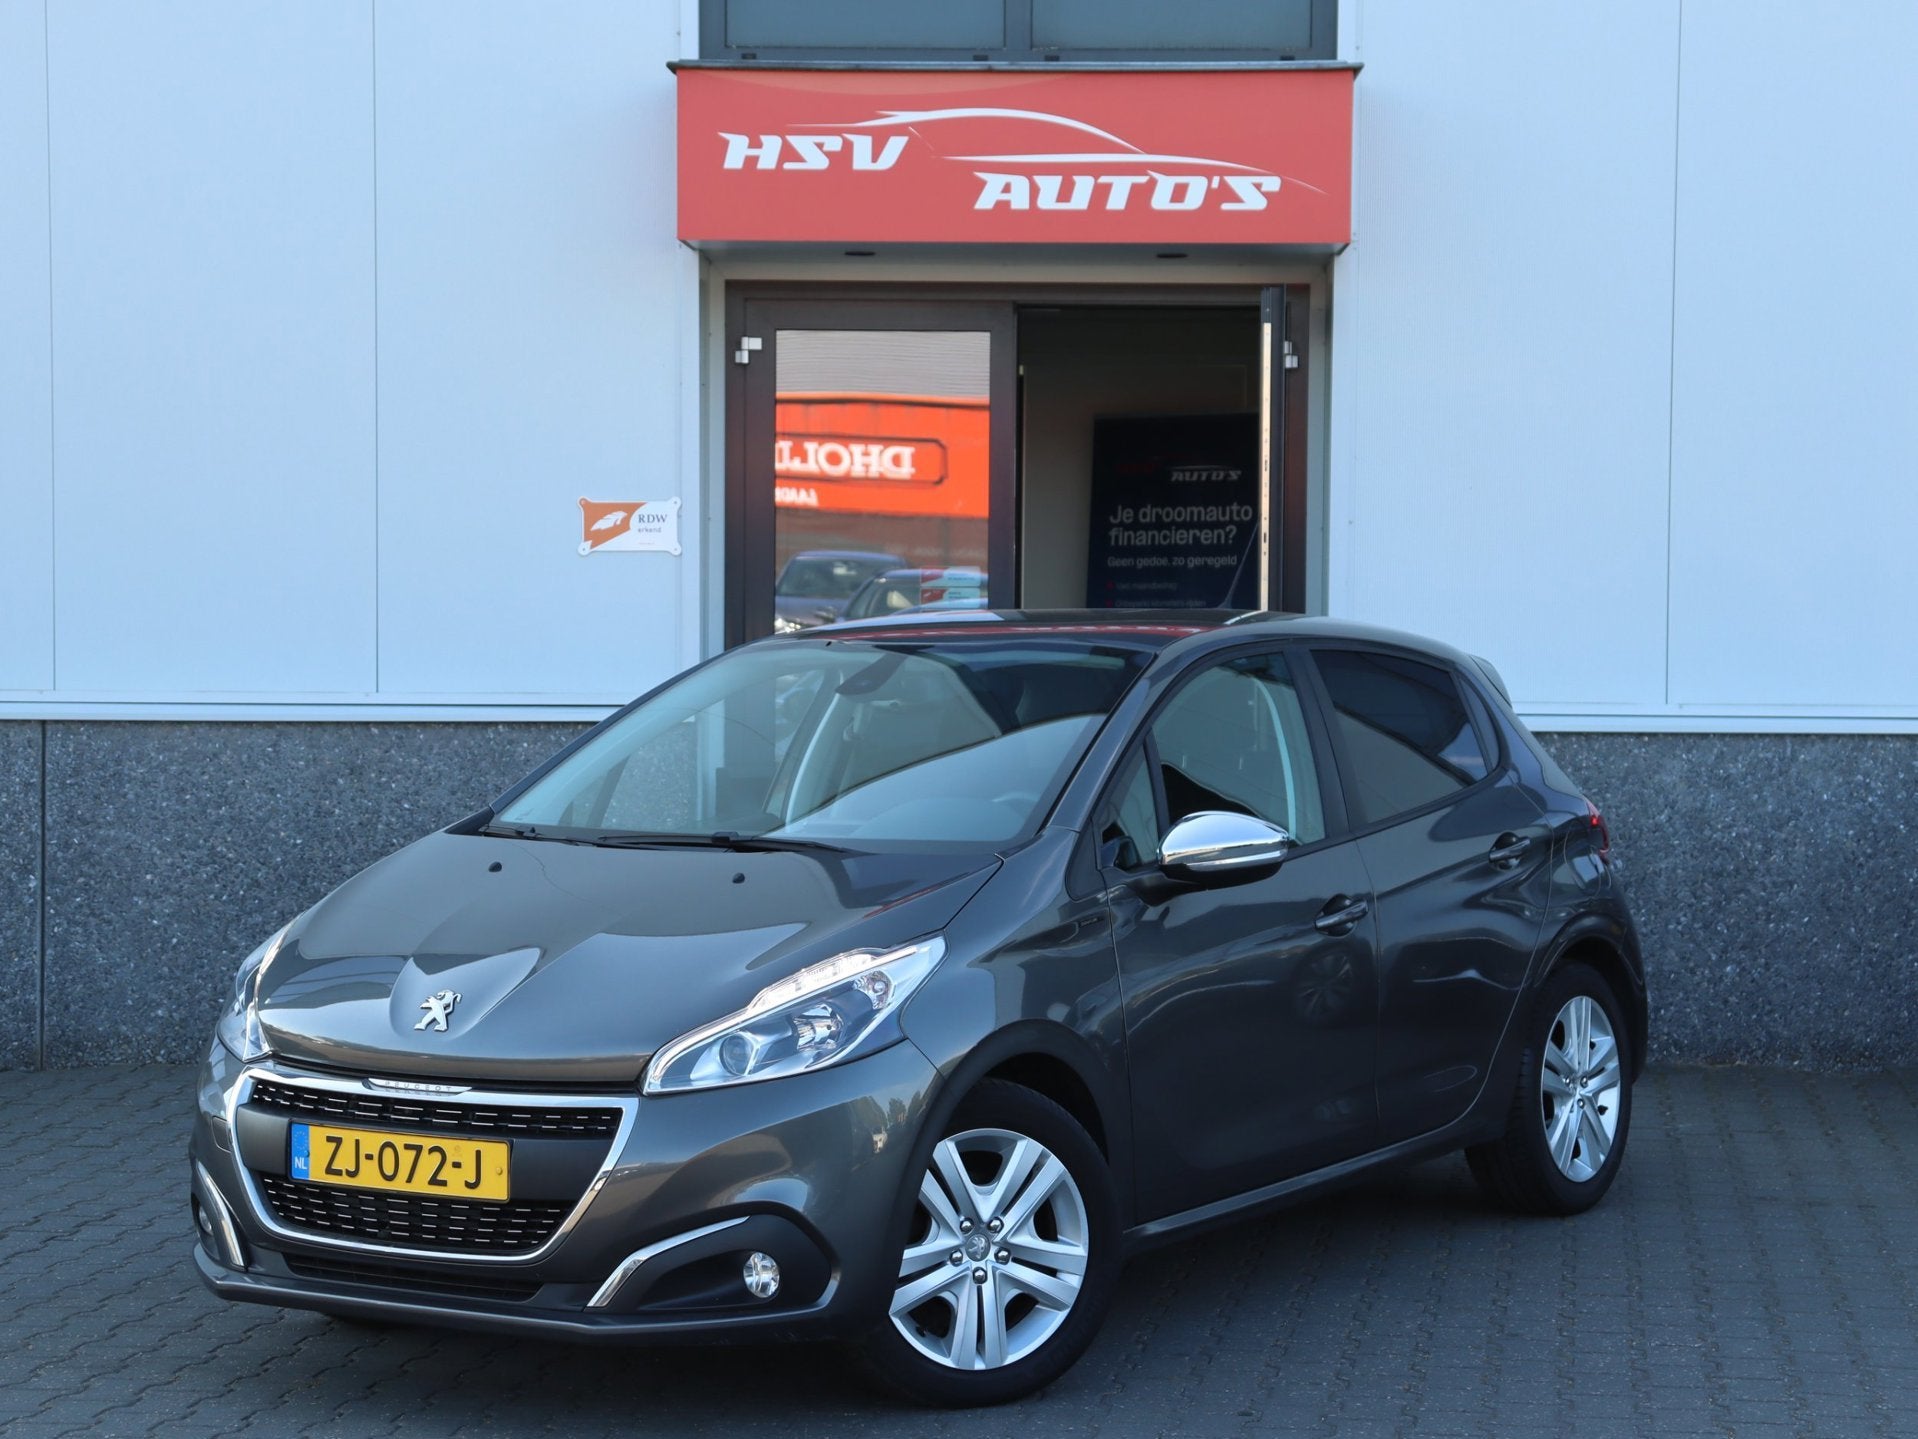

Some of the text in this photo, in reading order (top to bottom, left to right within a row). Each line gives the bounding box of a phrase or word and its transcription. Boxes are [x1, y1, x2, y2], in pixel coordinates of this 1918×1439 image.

[717, 131, 910, 171] HSV
[973, 170, 1282, 211] AUTO'S
[638, 513, 668, 524] RDW
[1109, 502, 1253, 524] Je droomauto
[1108, 525, 1237, 547] financieren?
[1107, 556, 1134, 568] Geen
[1172, 557, 1186, 567] zo
[1187, 554, 1237, 569] geregeld
[294, 1156, 308, 1171] NL
[324, 1135, 482, 1190] ZJ-072-J
